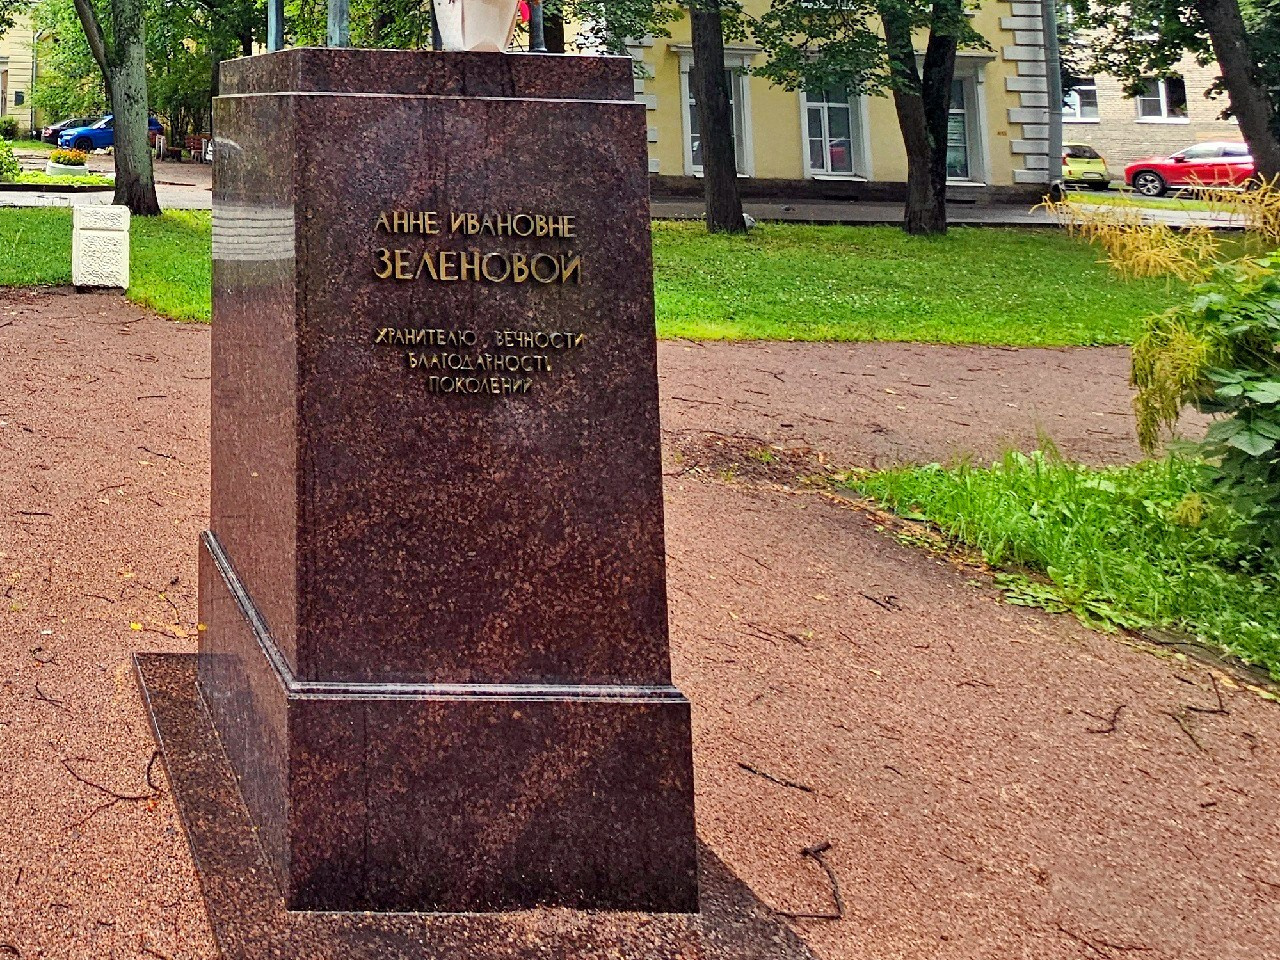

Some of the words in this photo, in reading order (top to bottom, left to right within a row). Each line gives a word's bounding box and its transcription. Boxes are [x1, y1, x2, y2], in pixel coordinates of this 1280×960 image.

[374, 211, 440, 235] АННЕ
[451, 212, 578, 238] ИВАНОВНЕ
[373, 248, 582, 283] ЗЕЛЕНОВОЙ
[375, 328, 478, 346] ХРАНИТЕЛЮ
[494, 330, 585, 349] ВЕЧНОСТИ
[429, 376, 534, 394] ПОКОЛЕНИЙ
